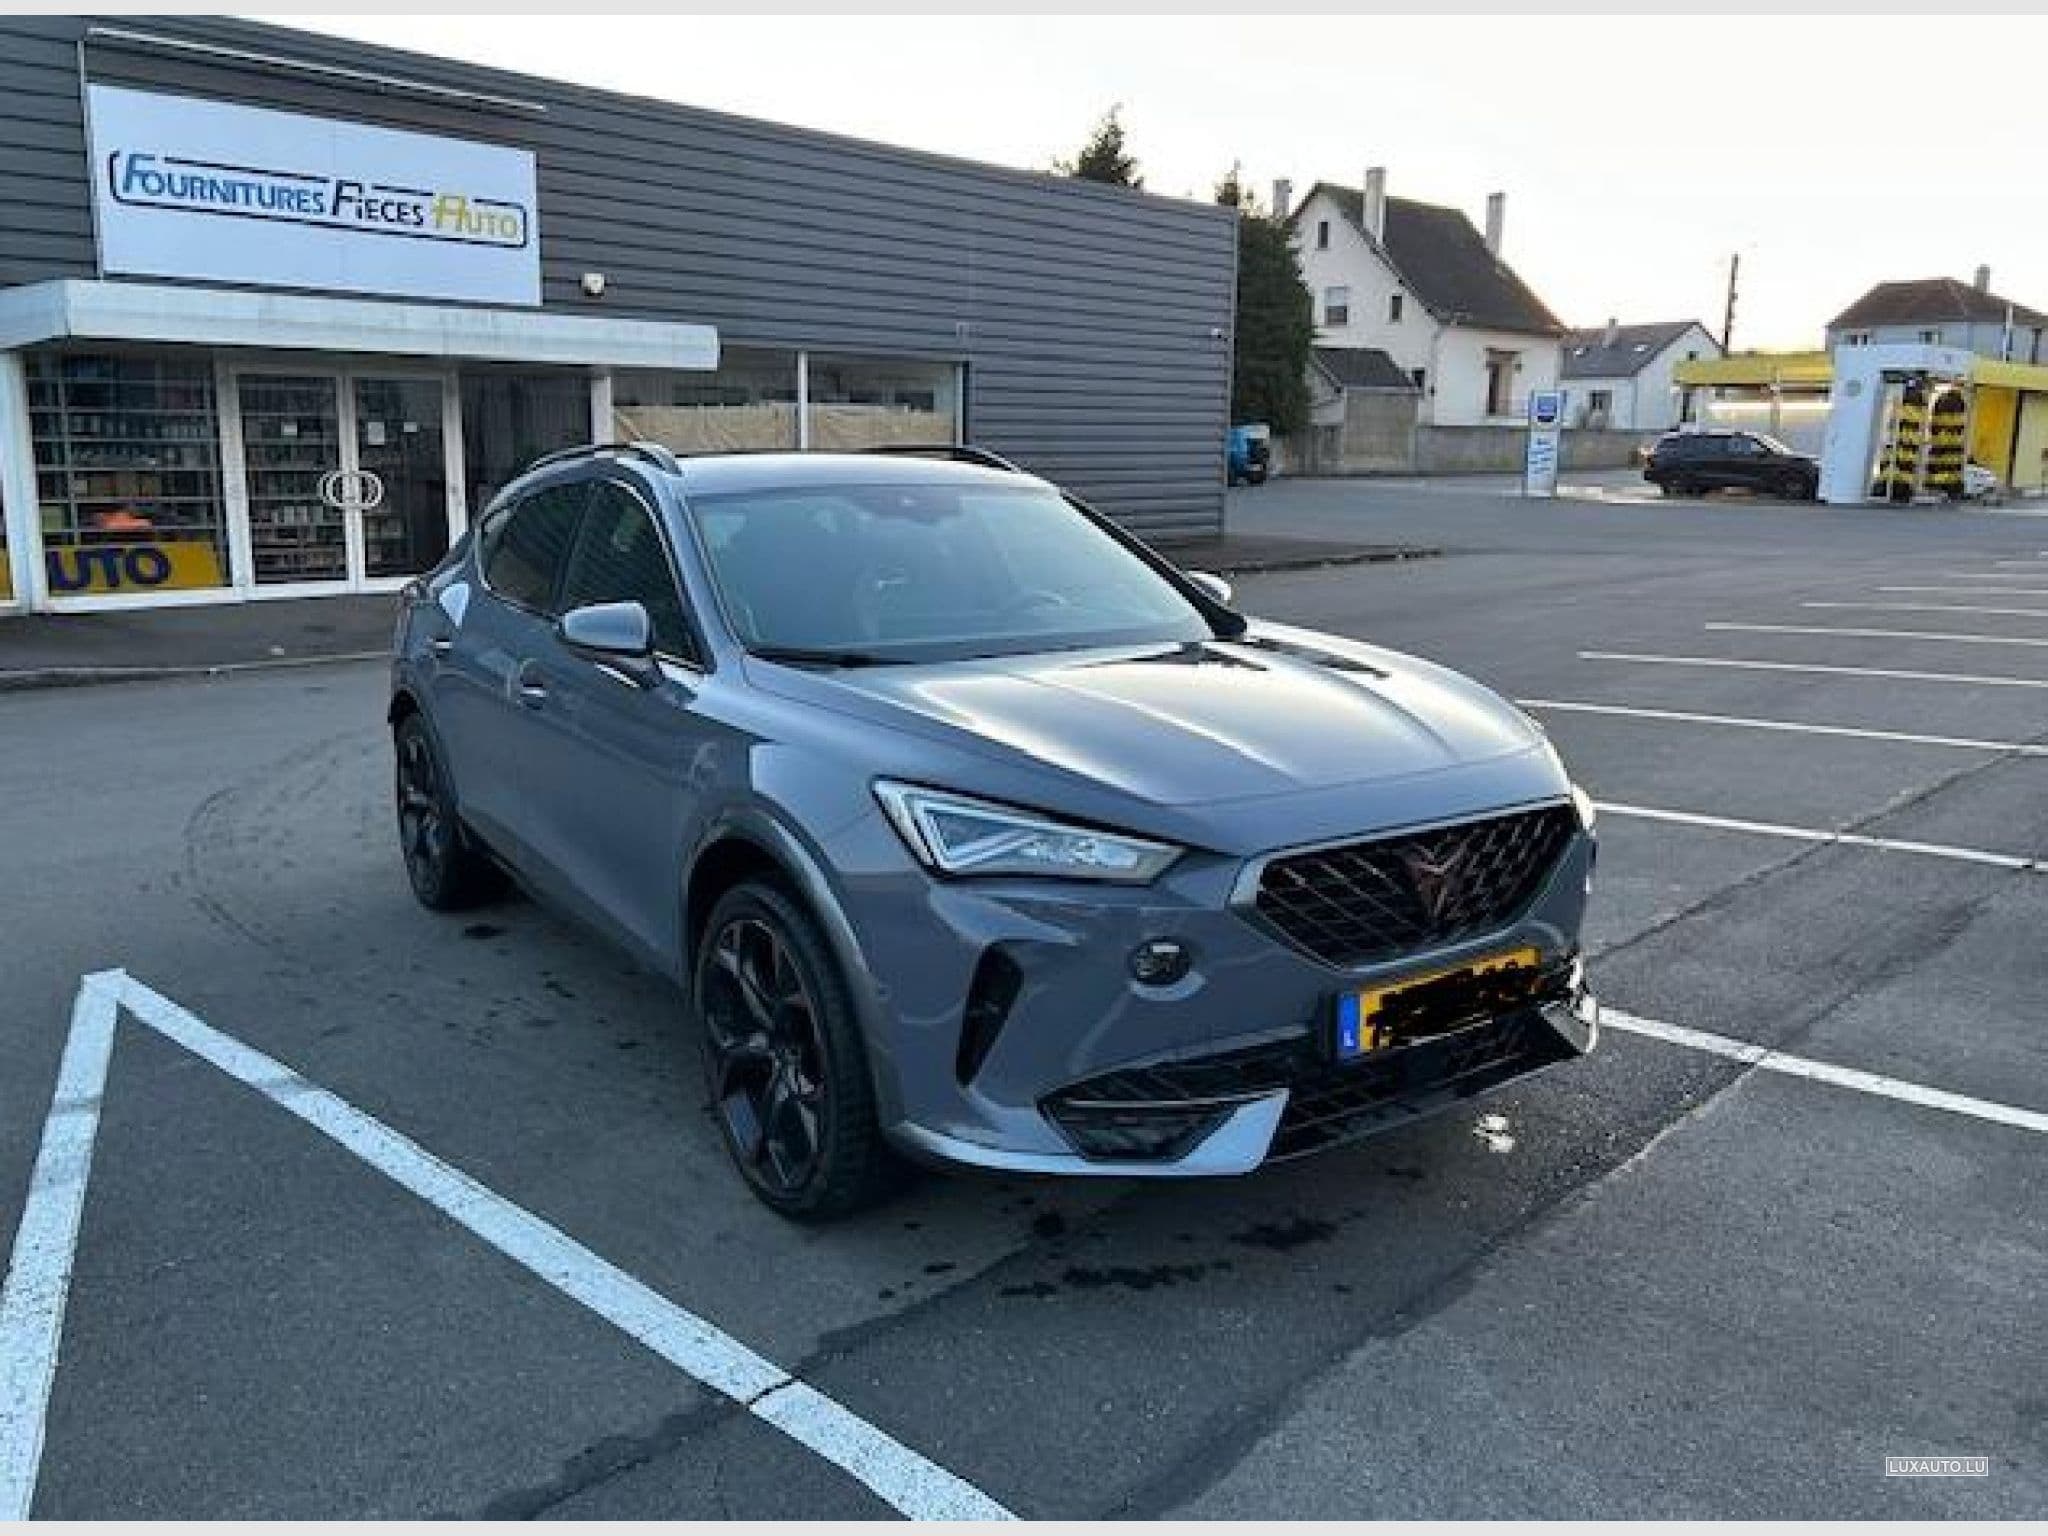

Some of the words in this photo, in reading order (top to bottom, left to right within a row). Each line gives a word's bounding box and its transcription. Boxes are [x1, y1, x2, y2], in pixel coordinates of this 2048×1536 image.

[122, 153, 325, 213] FOURNITURES
[431, 192, 518, 238] AUTO
[49, 547, 171, 590] UTO
